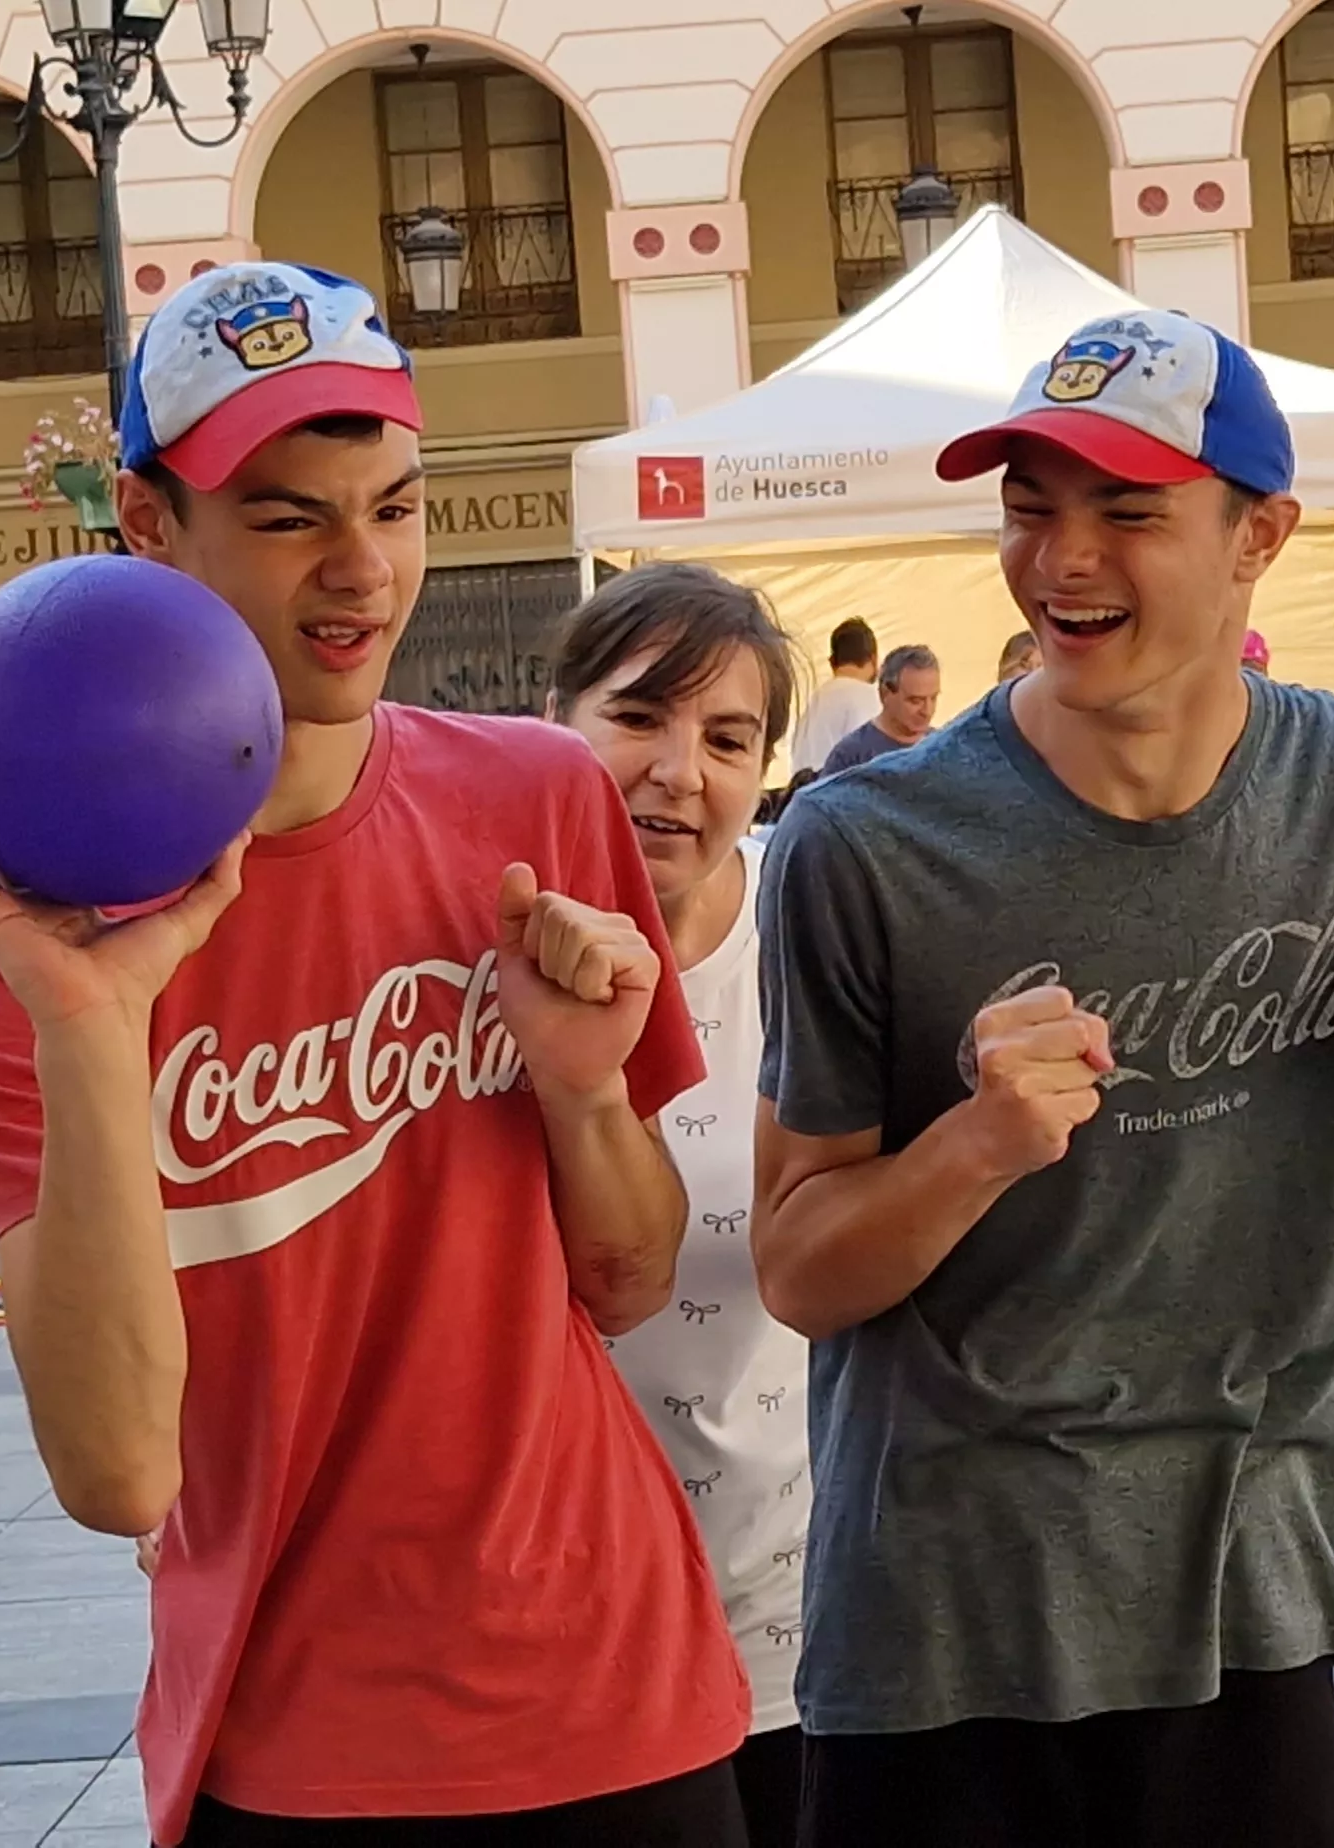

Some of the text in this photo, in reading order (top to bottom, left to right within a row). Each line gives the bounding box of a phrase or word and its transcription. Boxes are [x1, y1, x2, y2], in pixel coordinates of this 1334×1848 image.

[715, 448, 889, 478] Ayuntamiento
[715, 478, 848, 502] de Huesca
